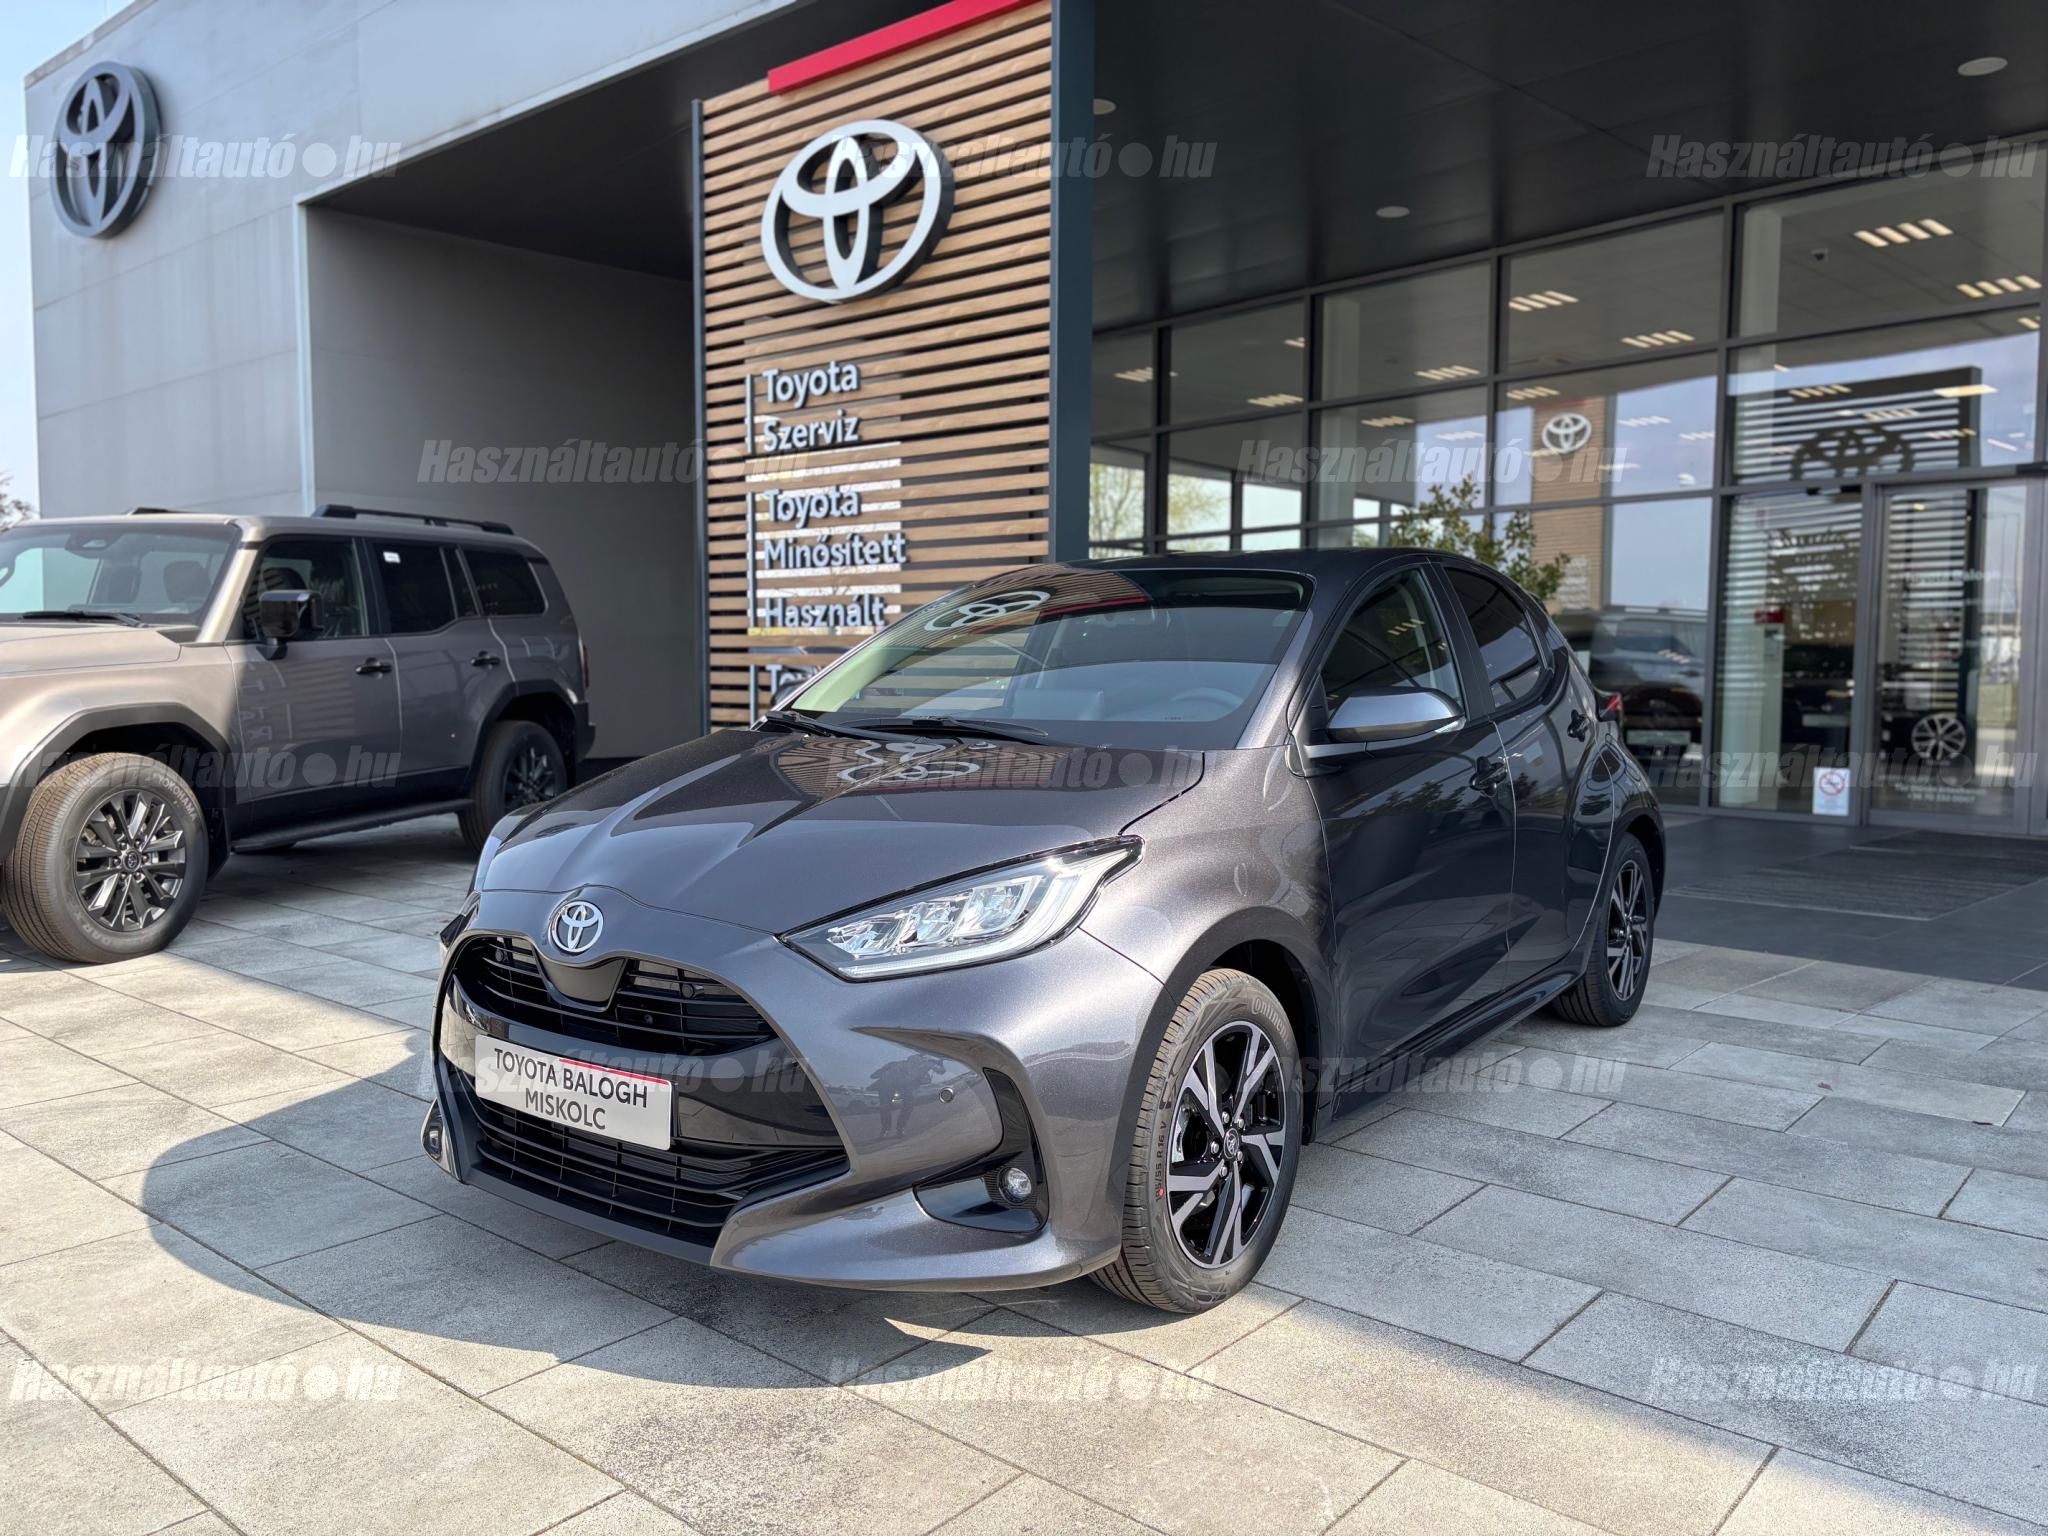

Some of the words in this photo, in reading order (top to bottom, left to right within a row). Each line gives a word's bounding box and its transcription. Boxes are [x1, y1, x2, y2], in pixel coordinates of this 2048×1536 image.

[763, 361, 860, 409] Toyota
[763, 409, 860, 452] Szerviz
[765, 485, 861, 529] Toyota
[764, 532, 908, 570] Minősített
[765, 593, 886, 628] Használt
[157, 772, 199, 822] YOKOHAMA
[494, 1048, 558, 1087] TOYOTA
[563, 1068, 648, 1108] BALOGH
[525, 1087, 606, 1130] MISKOLC
